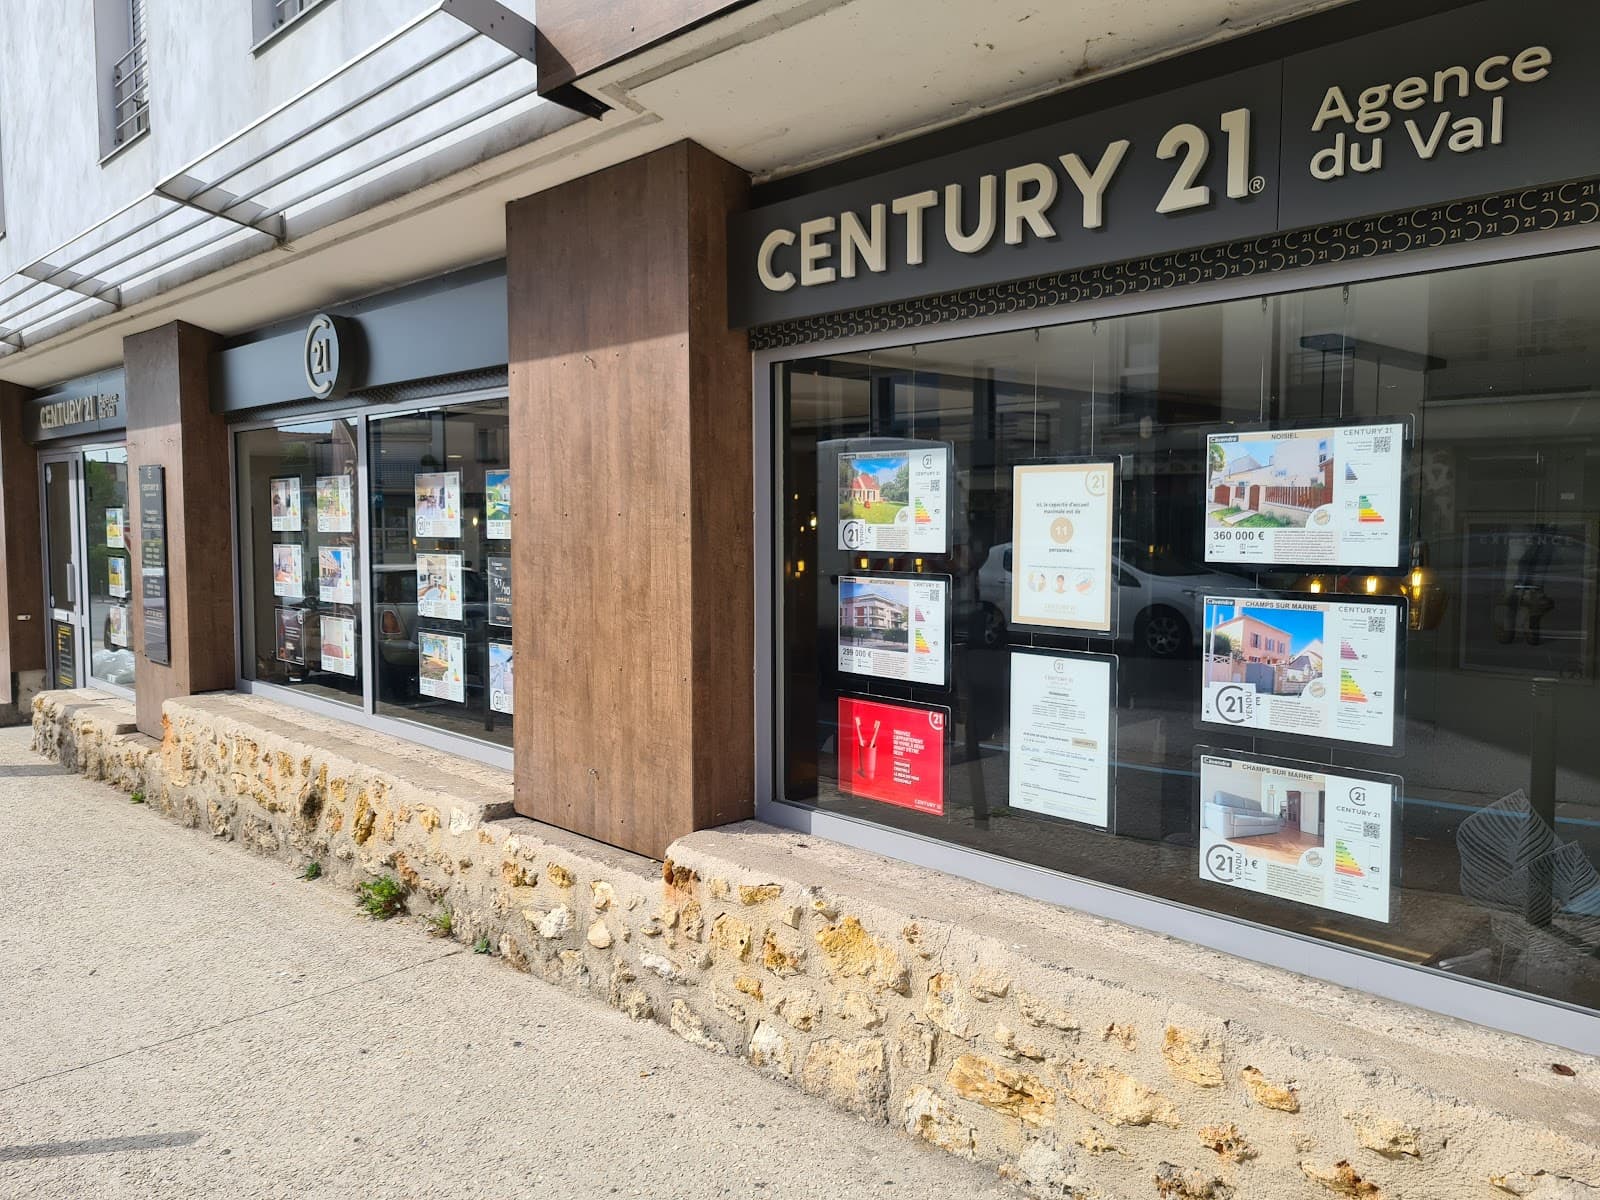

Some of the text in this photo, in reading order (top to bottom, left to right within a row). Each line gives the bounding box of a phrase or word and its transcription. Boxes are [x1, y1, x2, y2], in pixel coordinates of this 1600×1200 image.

[1311, 45, 1553, 133] Agence
[1309, 95, 1503, 180] du Val
[757, 107, 1251, 292] CENTURY 21
[1272, 239, 1280, 247] 21
[1303, 234, 1311, 242] 21
[1333, 228, 1342, 237] 21
[1364, 223, 1374, 232] 21
[1397, 217, 1407, 226] 21
[1432, 211, 1441, 220] 21
[1467, 205, 1477, 215] 21
[1504, 199, 1515, 208] 21
[1542, 191, 1554, 202] 21
[1582, 185, 1594, 195] 21
[1259, 260, 1267, 268] 21
[1289, 255, 1297, 264] 21
[1318, 251, 1327, 259] 21
[1350, 244, 1359, 254] 21
[1382, 240, 1391, 249] 21
[1416, 234, 1425, 244] 21
[1450, 229, 1460, 238] 21
[1487, 223, 1497, 232] 21
[1524, 217, 1535, 227] 21
[1563, 210, 1575, 221] 21
[40, 395, 95, 429] CENTURY 21
[1271, 431, 1300, 440] NOISIEL
[1344, 427, 1382, 436] CENTURY
[848, 529, 859, 542] 21
[1055, 526, 1068, 536] 11
[1213, 531, 1265, 541] 360 000 €
[1292, 603, 1318, 611] MARNE
[855, 649, 866, 658] 000
[1224, 695, 1244, 714] 21
[1245, 691, 1253, 720] VENDU
[1242, 764, 1271, 774] CHAMPS
[1272, 768, 1286, 776] SUR
[1288, 771, 1313, 781] MARNE
[1355, 791, 1366, 801] 21
[1336, 805, 1372, 816] CENTURY
[1215, 854, 1234, 874] 21
[1251, 859, 1258, 869] €
